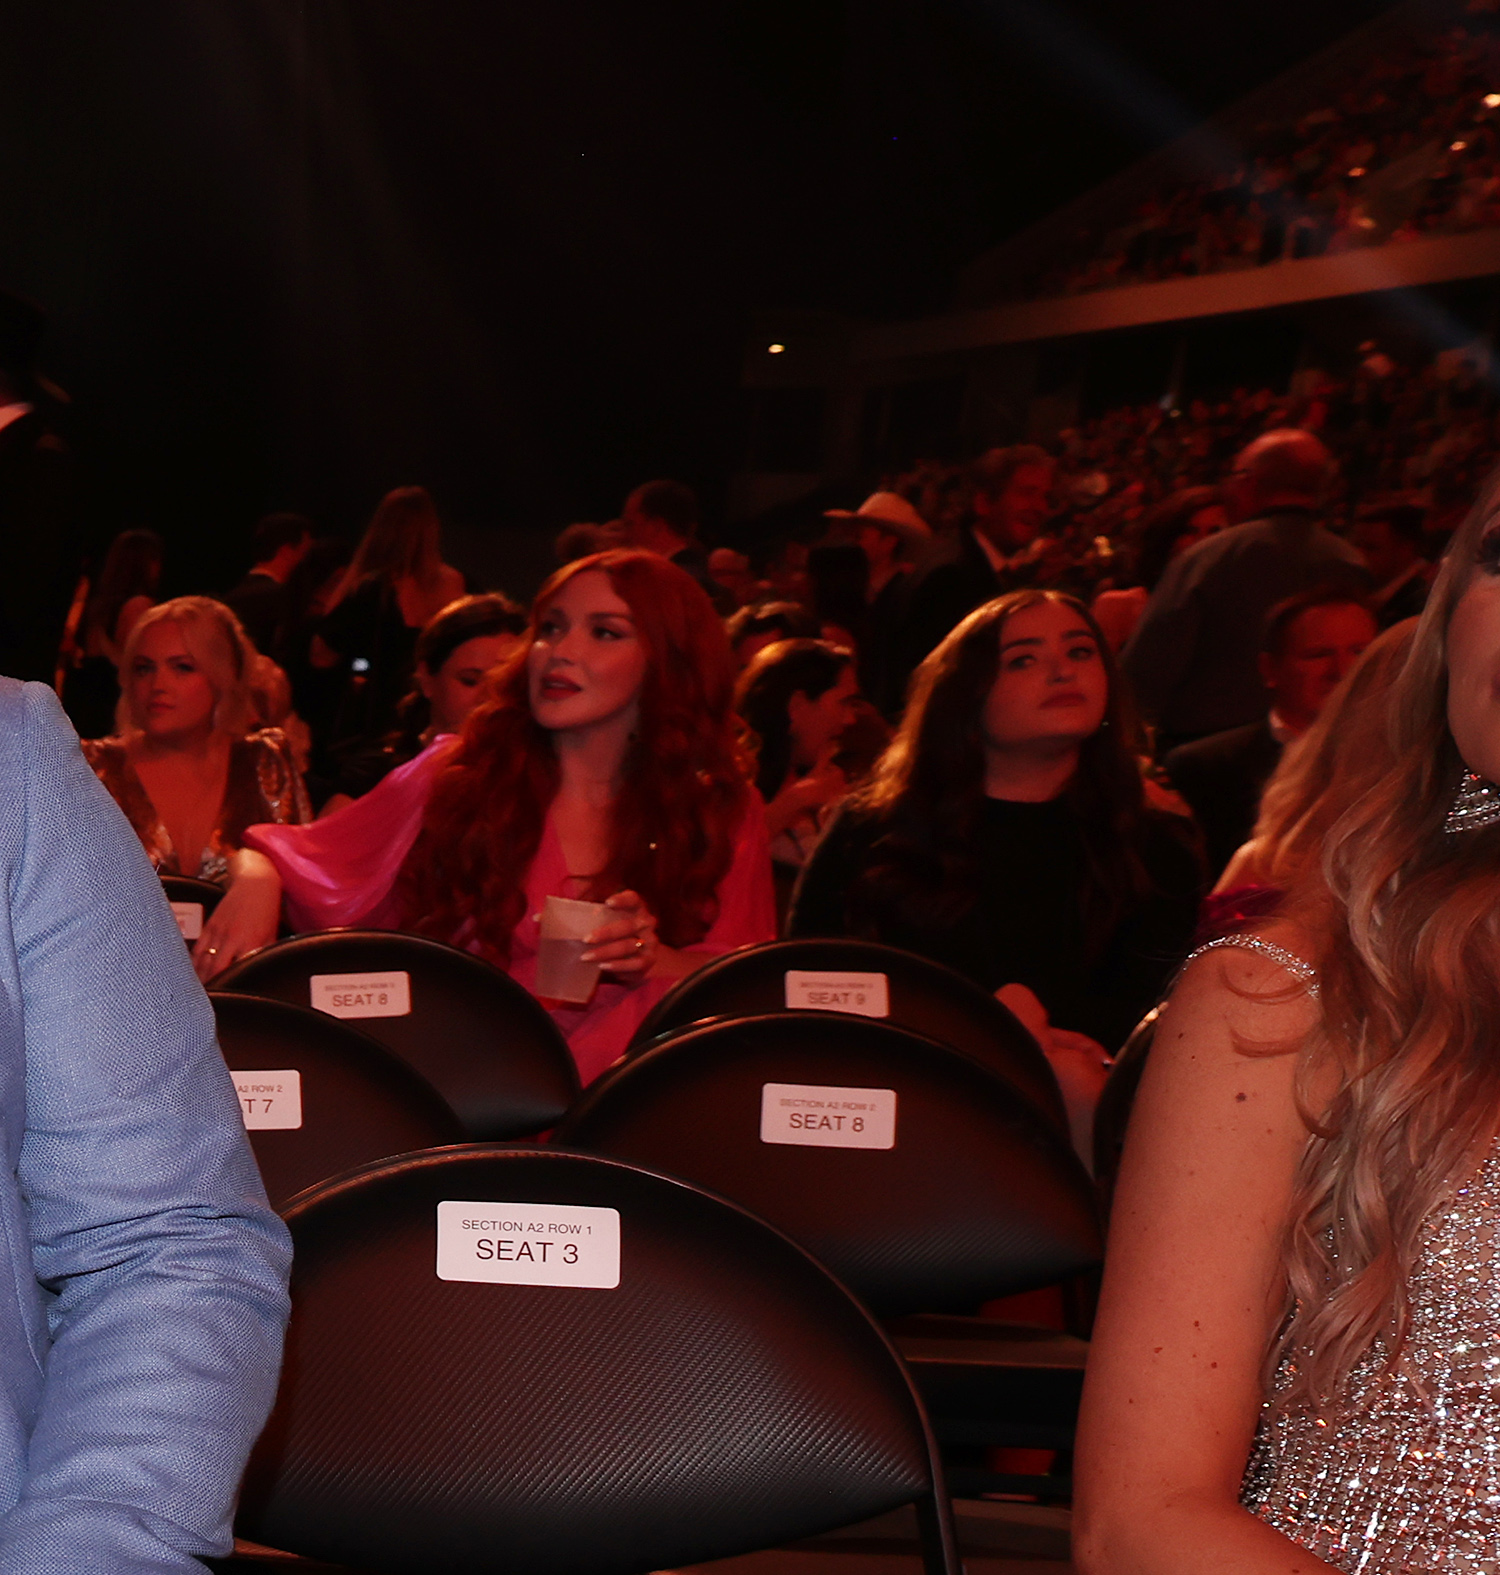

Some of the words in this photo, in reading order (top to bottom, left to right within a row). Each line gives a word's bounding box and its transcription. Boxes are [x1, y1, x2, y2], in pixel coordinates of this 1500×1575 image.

[332, 993, 374, 1007] SEAT
[808, 992, 850, 1005] SEAT
[251, 1085, 275, 1093] ROW
[277, 1085, 283, 1093] 2
[262, 1098, 273, 1114] 7
[780, 1098, 824, 1109] SECTION
[789, 1112, 847, 1131] SEAT
[852, 1117, 864, 1133] 8
[462, 1219, 523, 1232] SECTION
[527, 1222, 544, 1233] A2
[548, 1223, 583, 1234] ROW
[586, 1225, 592, 1235] 1
[476, 1239, 554, 1263] SEAT
[563, 1243, 579, 1265] 3
